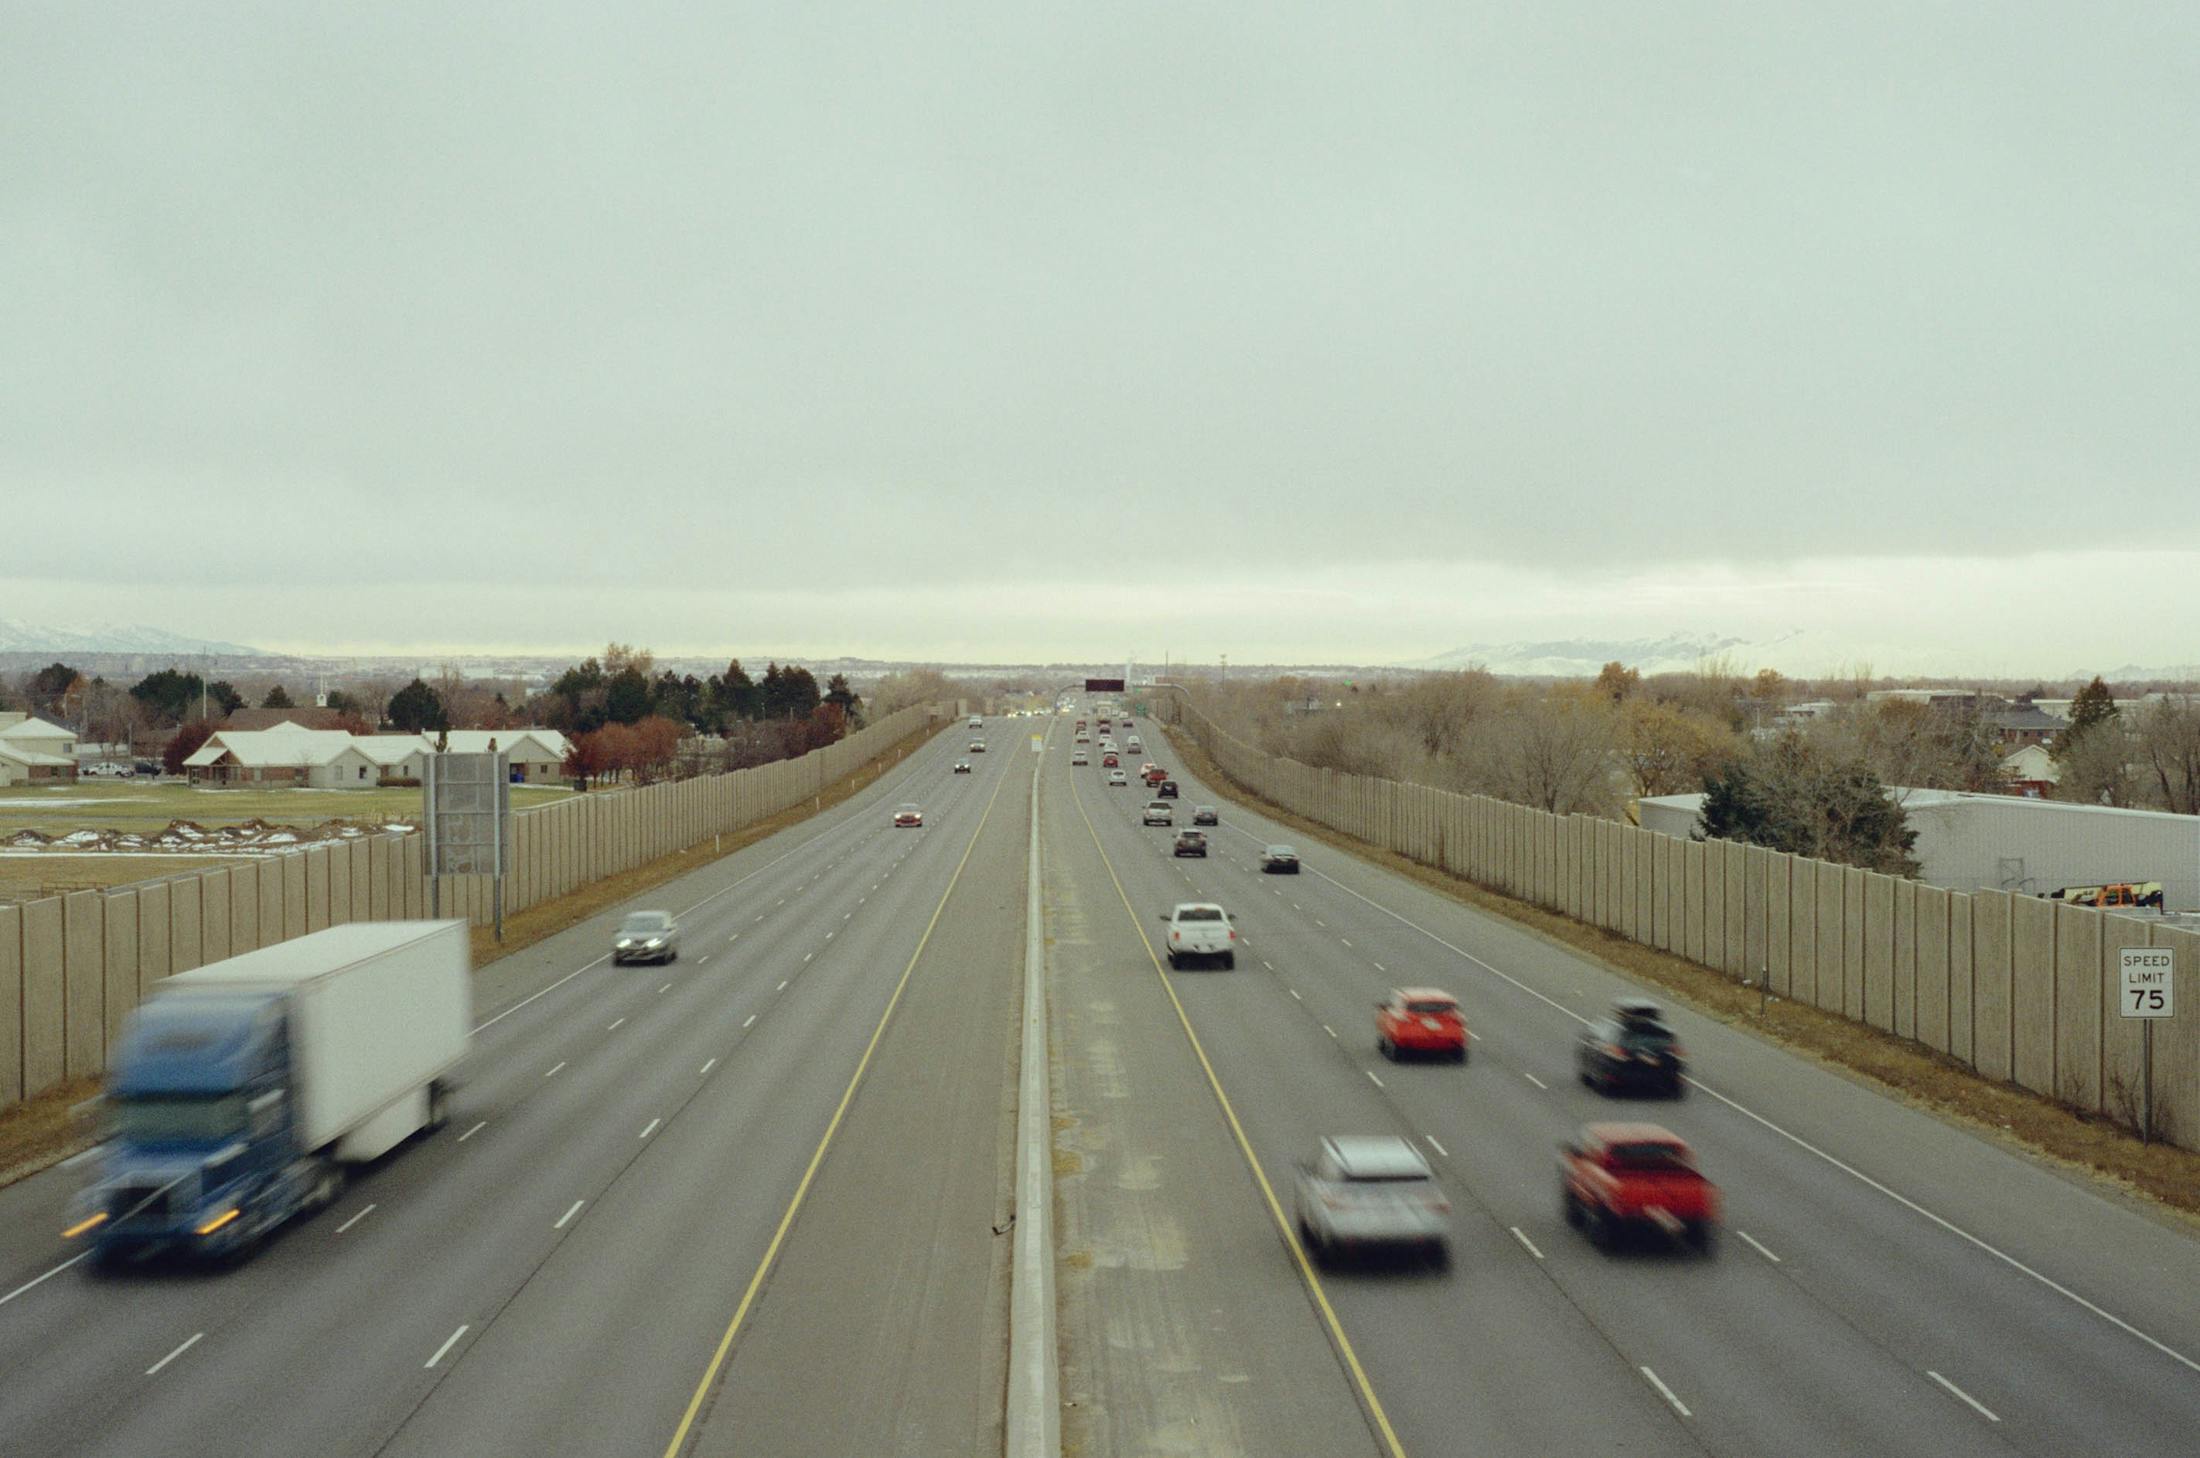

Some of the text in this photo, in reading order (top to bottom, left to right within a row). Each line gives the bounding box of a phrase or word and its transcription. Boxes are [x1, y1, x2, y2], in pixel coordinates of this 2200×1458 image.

[2123, 956, 2170, 967] SPEED
[2129, 973, 2164, 983] LIMIT
[2129, 990, 2164, 1010] 75
